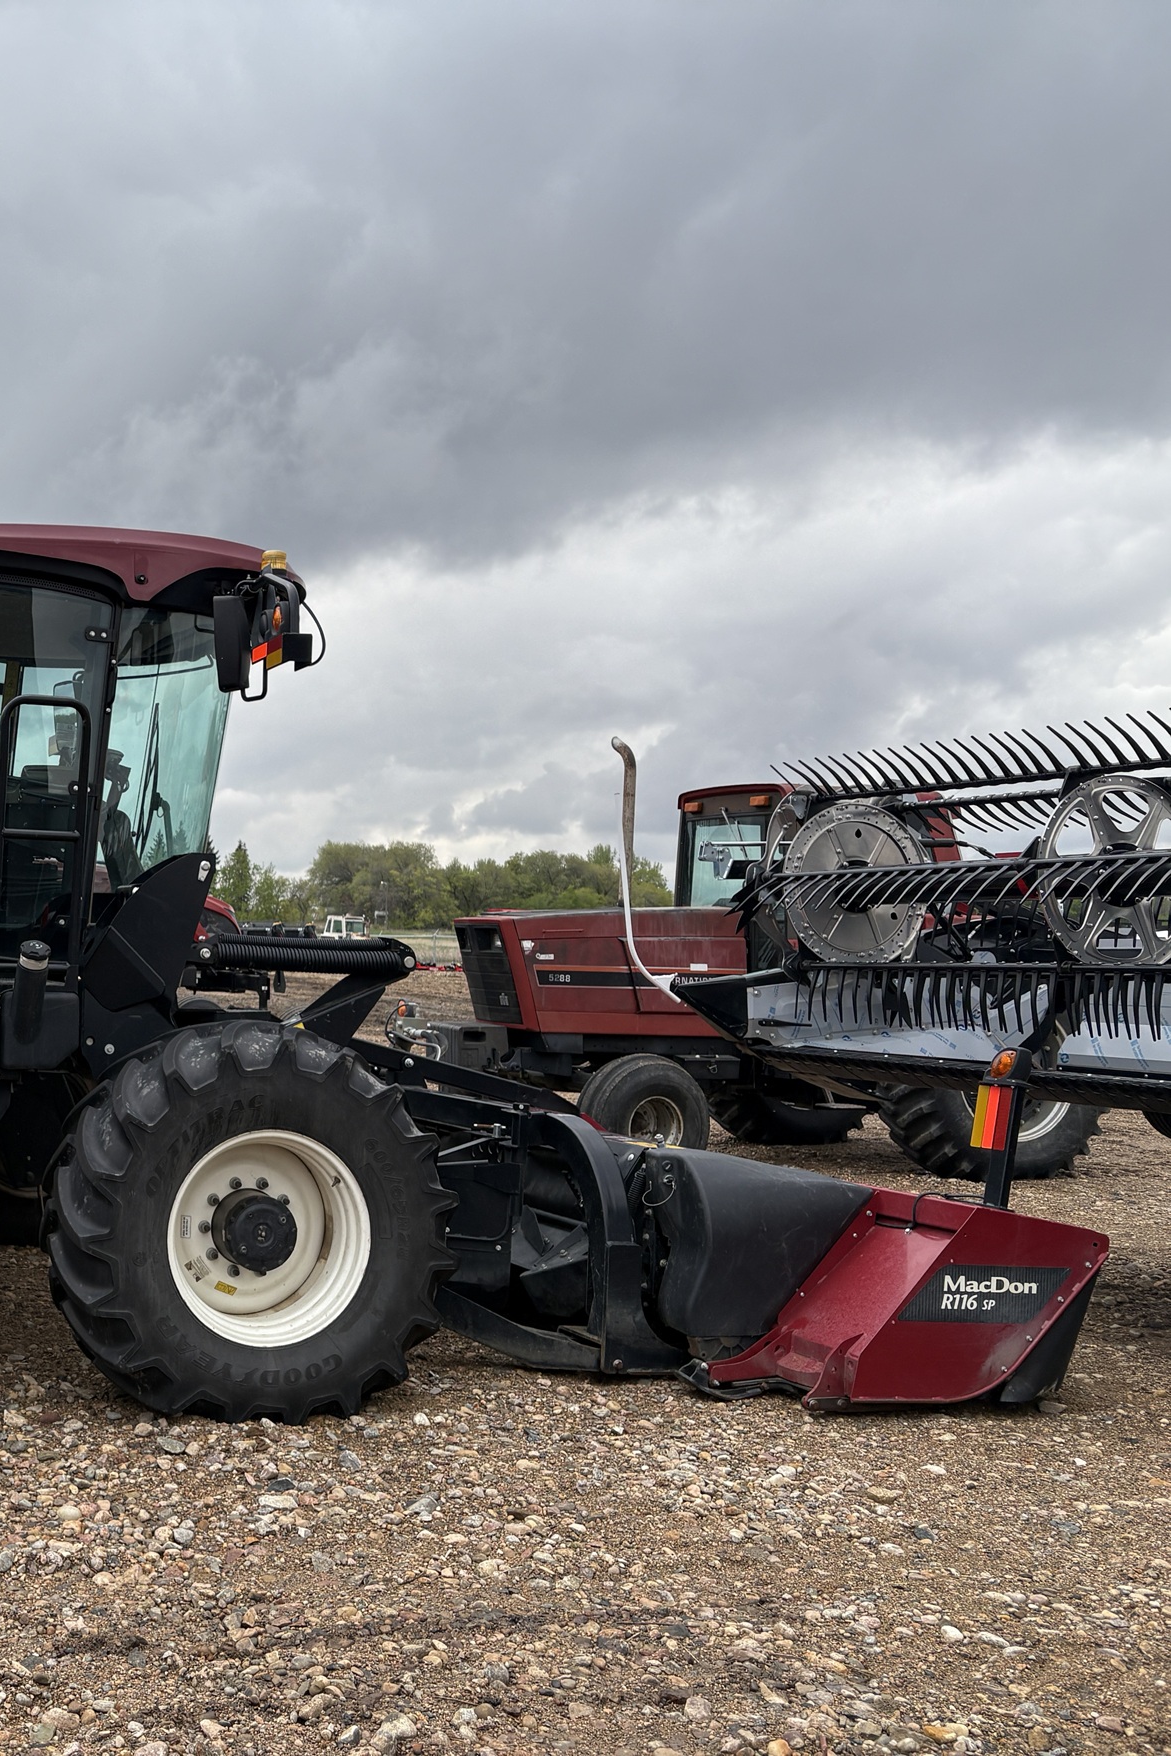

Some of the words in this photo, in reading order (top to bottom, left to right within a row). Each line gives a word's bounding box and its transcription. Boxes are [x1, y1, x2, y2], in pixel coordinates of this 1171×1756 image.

[548, 973, 571, 983] 5288
[943, 1275, 1038, 1294] MacDon
[941, 1294, 978, 1310] R116
[982, 1300, 996, 1310] SP
[156, 1315, 343, 1387] GOODYEAR
